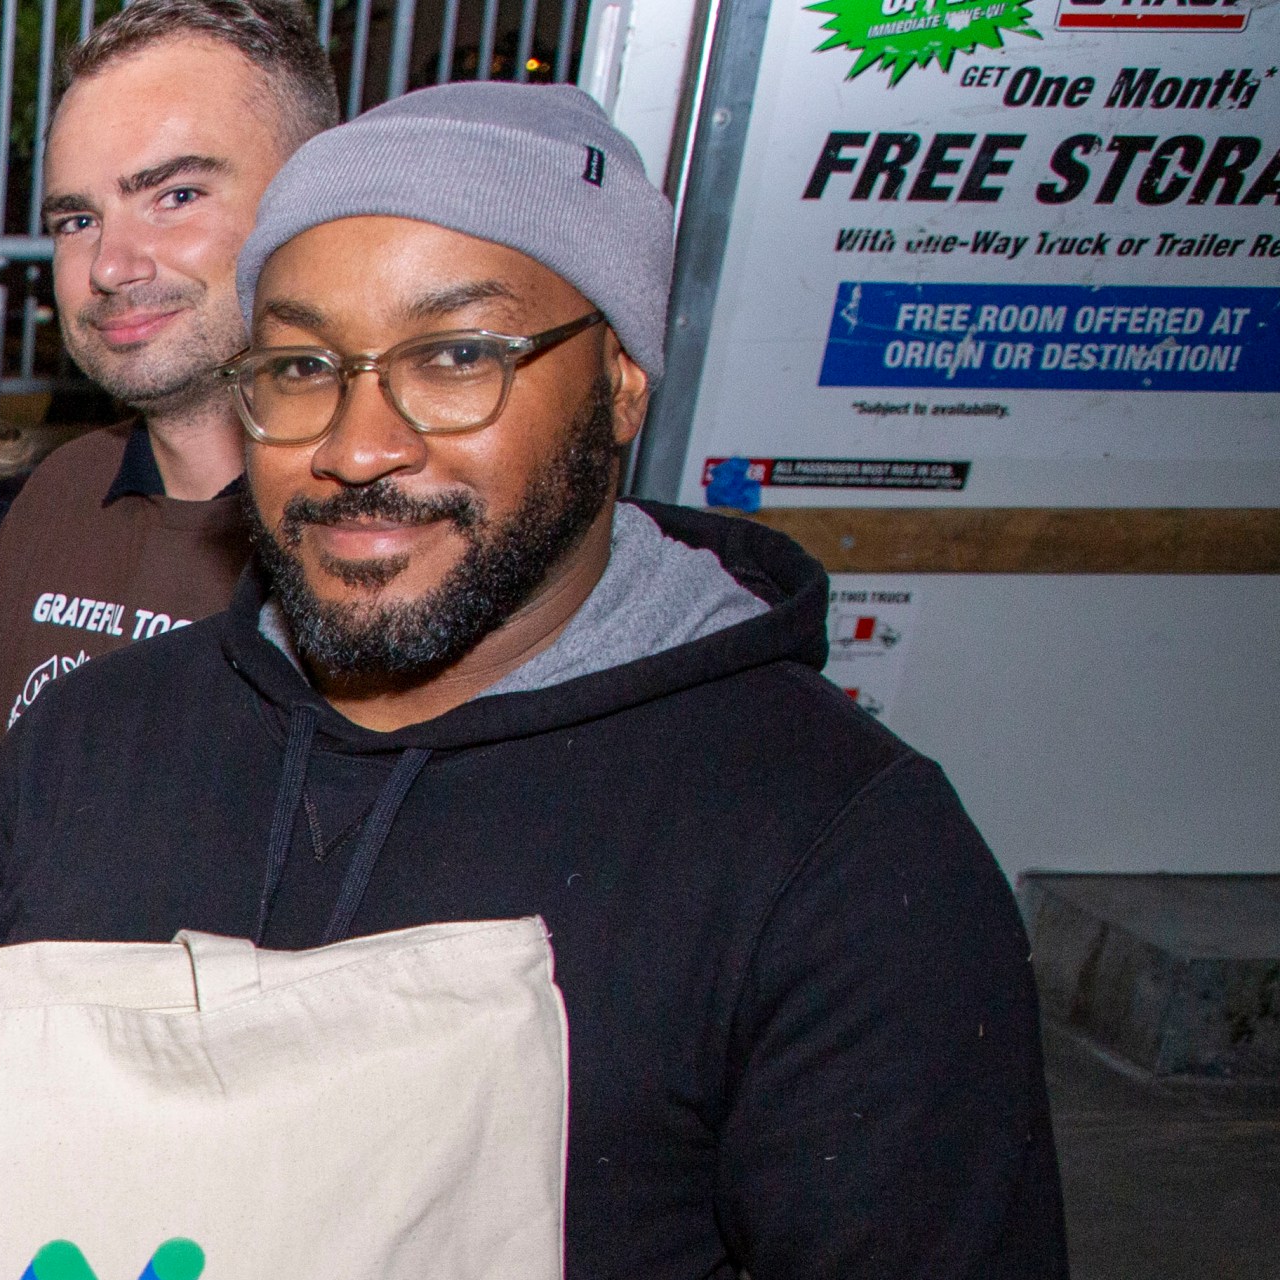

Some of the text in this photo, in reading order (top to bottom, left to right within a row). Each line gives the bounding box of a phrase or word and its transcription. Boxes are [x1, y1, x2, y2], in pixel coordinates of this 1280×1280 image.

[867, 14, 940, 39] IMMEDIATE
[960, 66, 1011, 87] GET
[1003, 65, 1095, 110] One
[802, 131, 1027, 201] FREE
[834, 227, 896, 253] With
[1034, 231, 1111, 255] Truck
[1116, 237, 1151, 256] or
[1153, 232, 1246, 257] Trailer
[895, 303, 1251, 335] FREE ROOM OFFERED AT
[883, 339, 1242, 372] ORIGIN OR DESTINATION!
